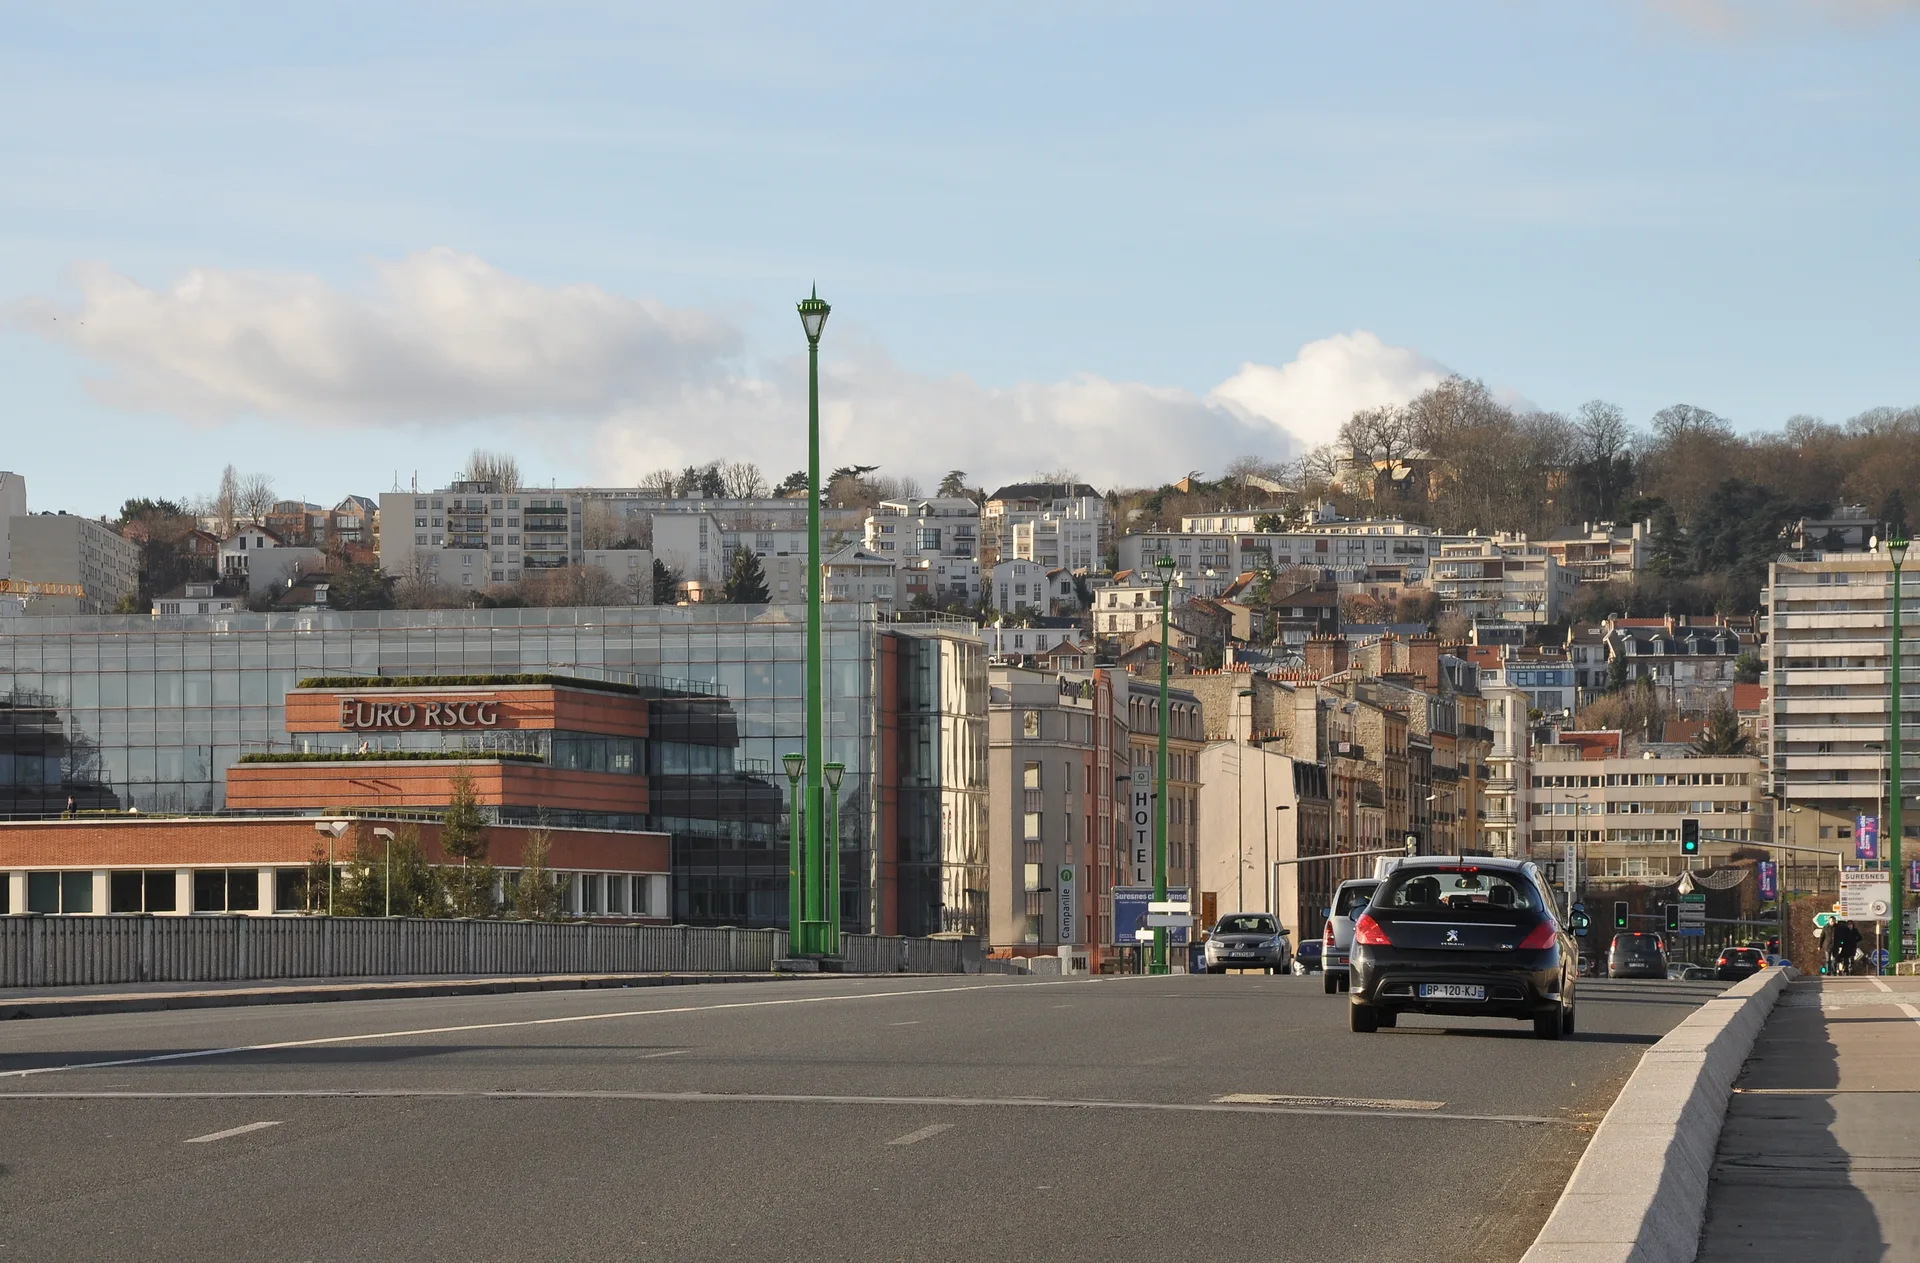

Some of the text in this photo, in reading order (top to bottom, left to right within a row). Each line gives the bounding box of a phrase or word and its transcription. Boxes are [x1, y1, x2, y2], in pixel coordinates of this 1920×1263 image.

[338, 697, 498, 727] EURO RSCG
[1135, 792, 1148, 882] HOTEL
[1114, 892, 1147, 900] Suresnes
[1061, 888, 1073, 939] Campanile
[1427, 985, 1477, 996] BP-120-KJ
